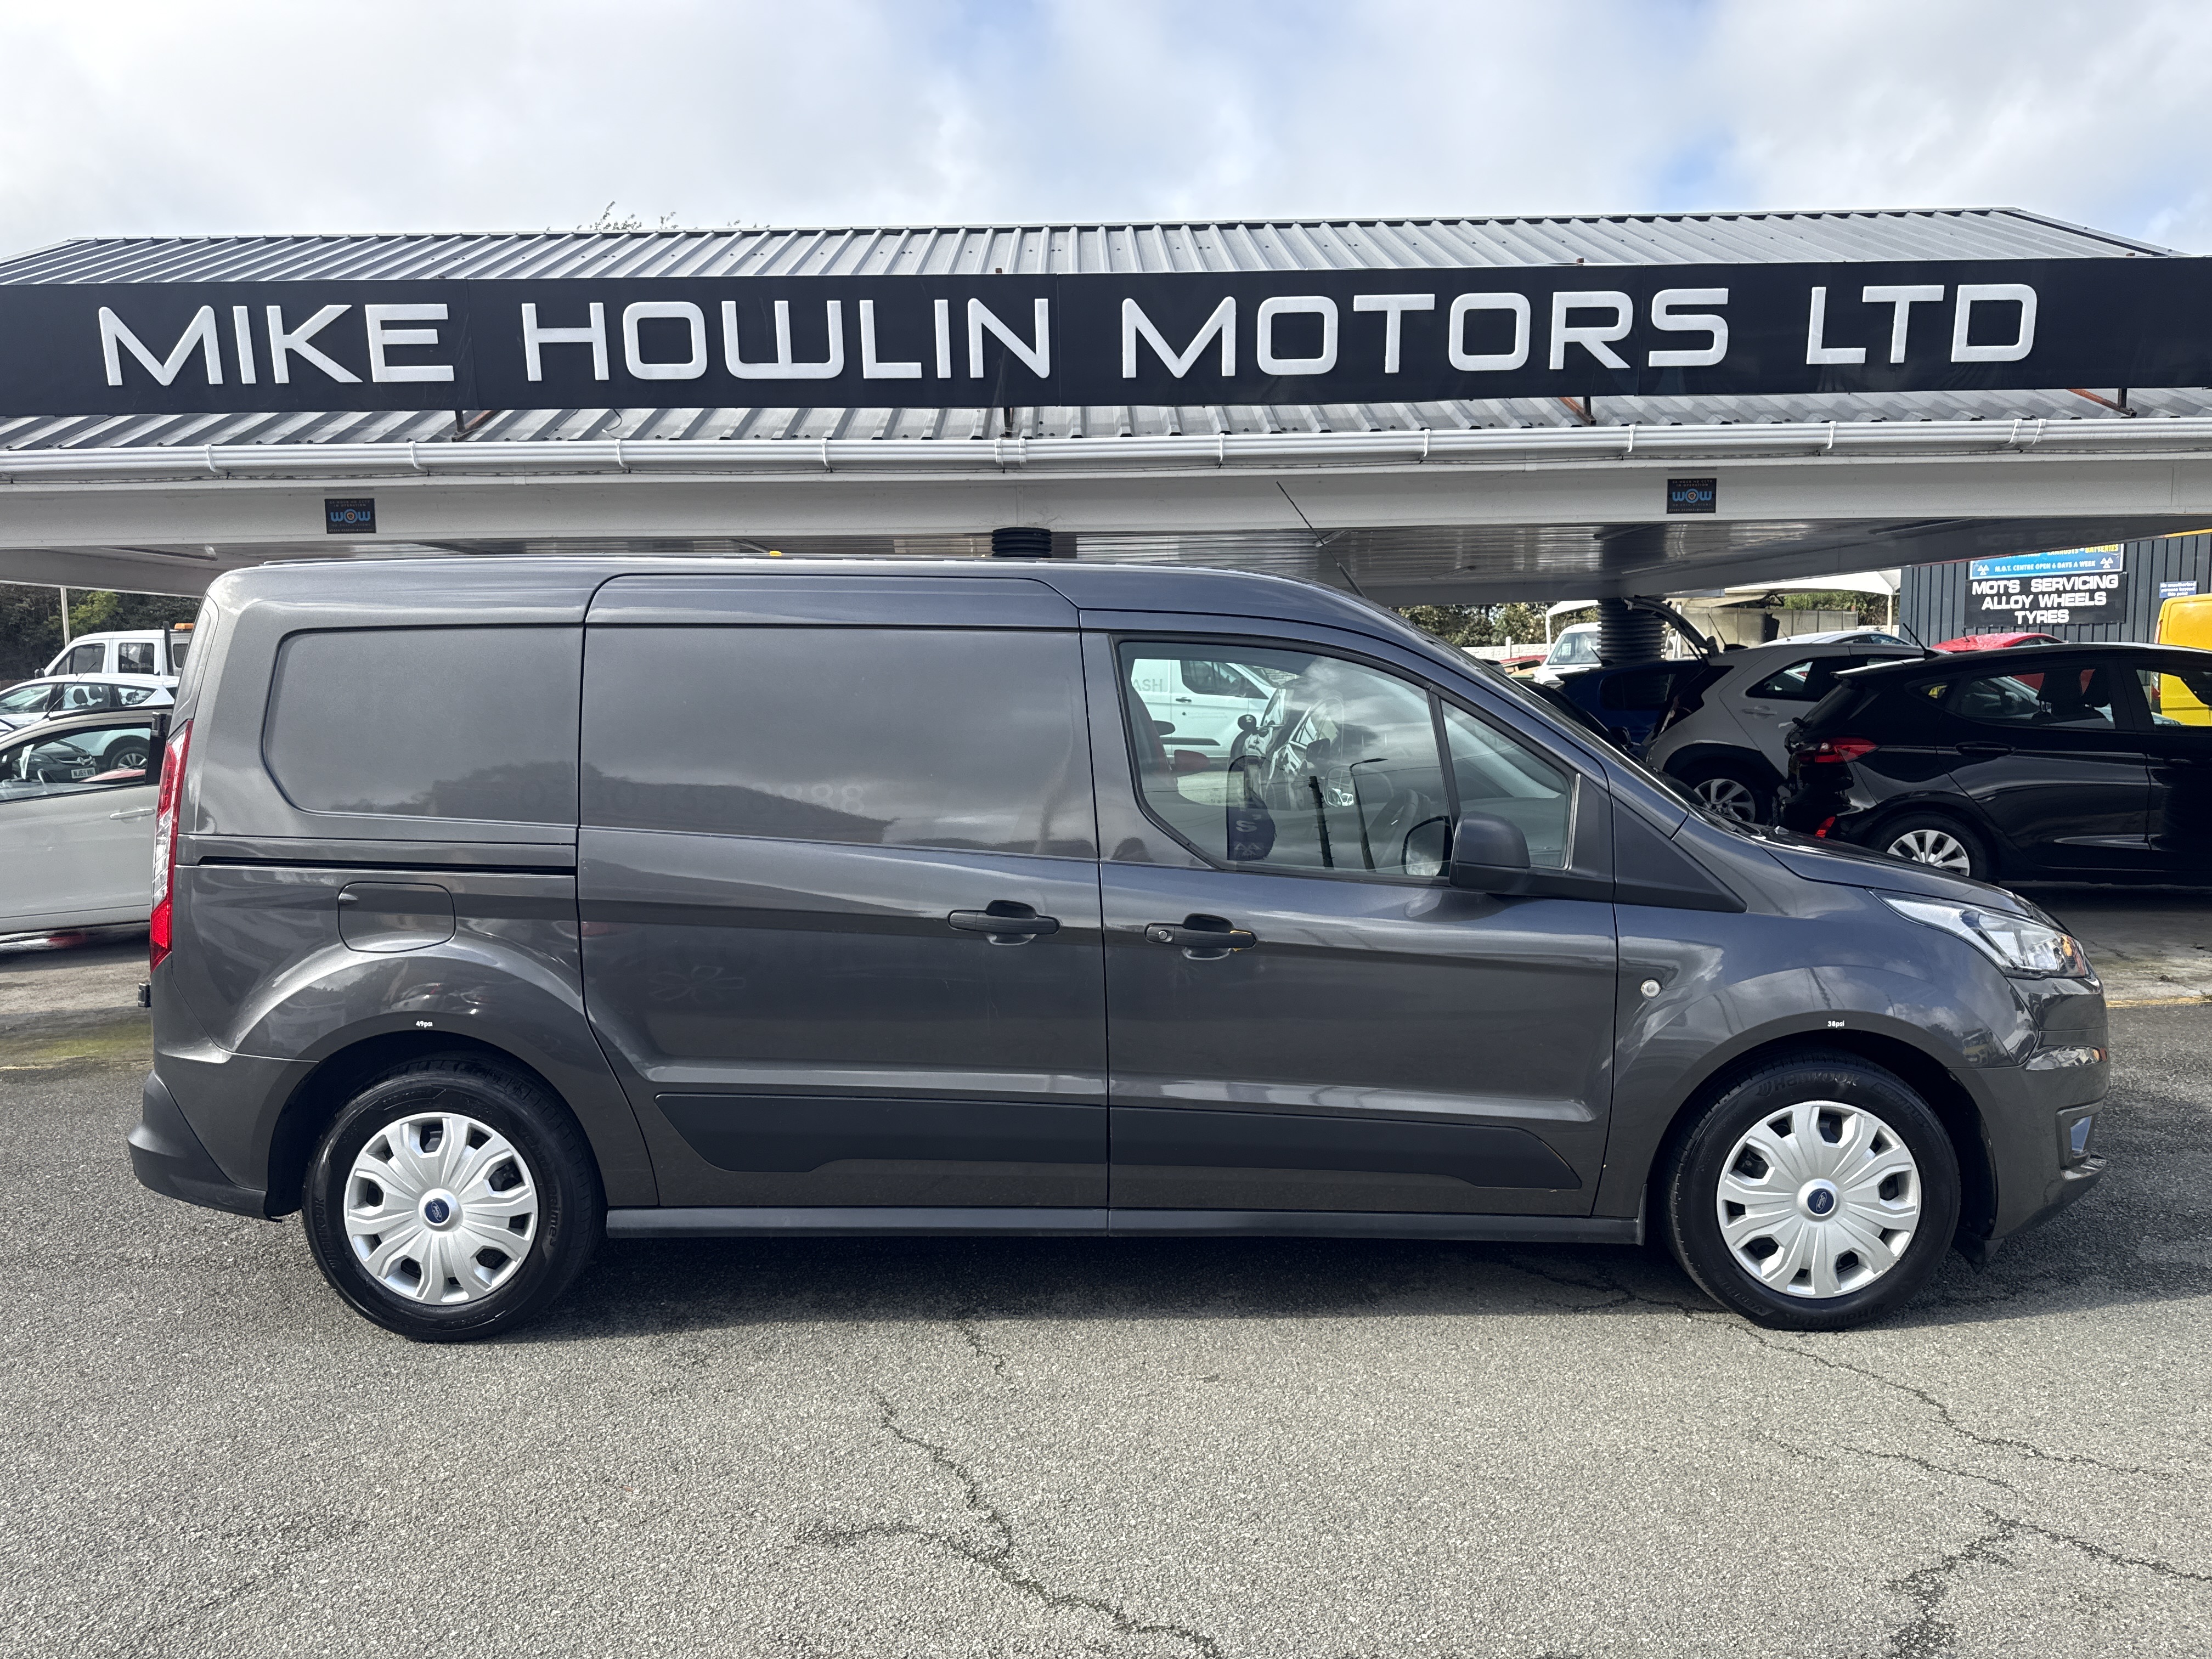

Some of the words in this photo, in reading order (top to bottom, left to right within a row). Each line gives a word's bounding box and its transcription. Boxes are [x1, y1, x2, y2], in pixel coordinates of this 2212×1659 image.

[98, 303, 455, 386] MIKE
[521, 298, 1050, 382] HOWLIN
[1122, 288, 1729, 379] MOTORS
[1806, 284, 2038, 365] LTD
[2085, 544, 2118, 554] BATTERIES
[1972, 580, 2020, 595] MOT'S
[2030, 574, 2119, 592] SERVICING
[1981, 595, 2034, 610] ALLOY
[2039, 591, 2107, 608] WHEELS
[2015, 609, 2069, 624] TYRES
